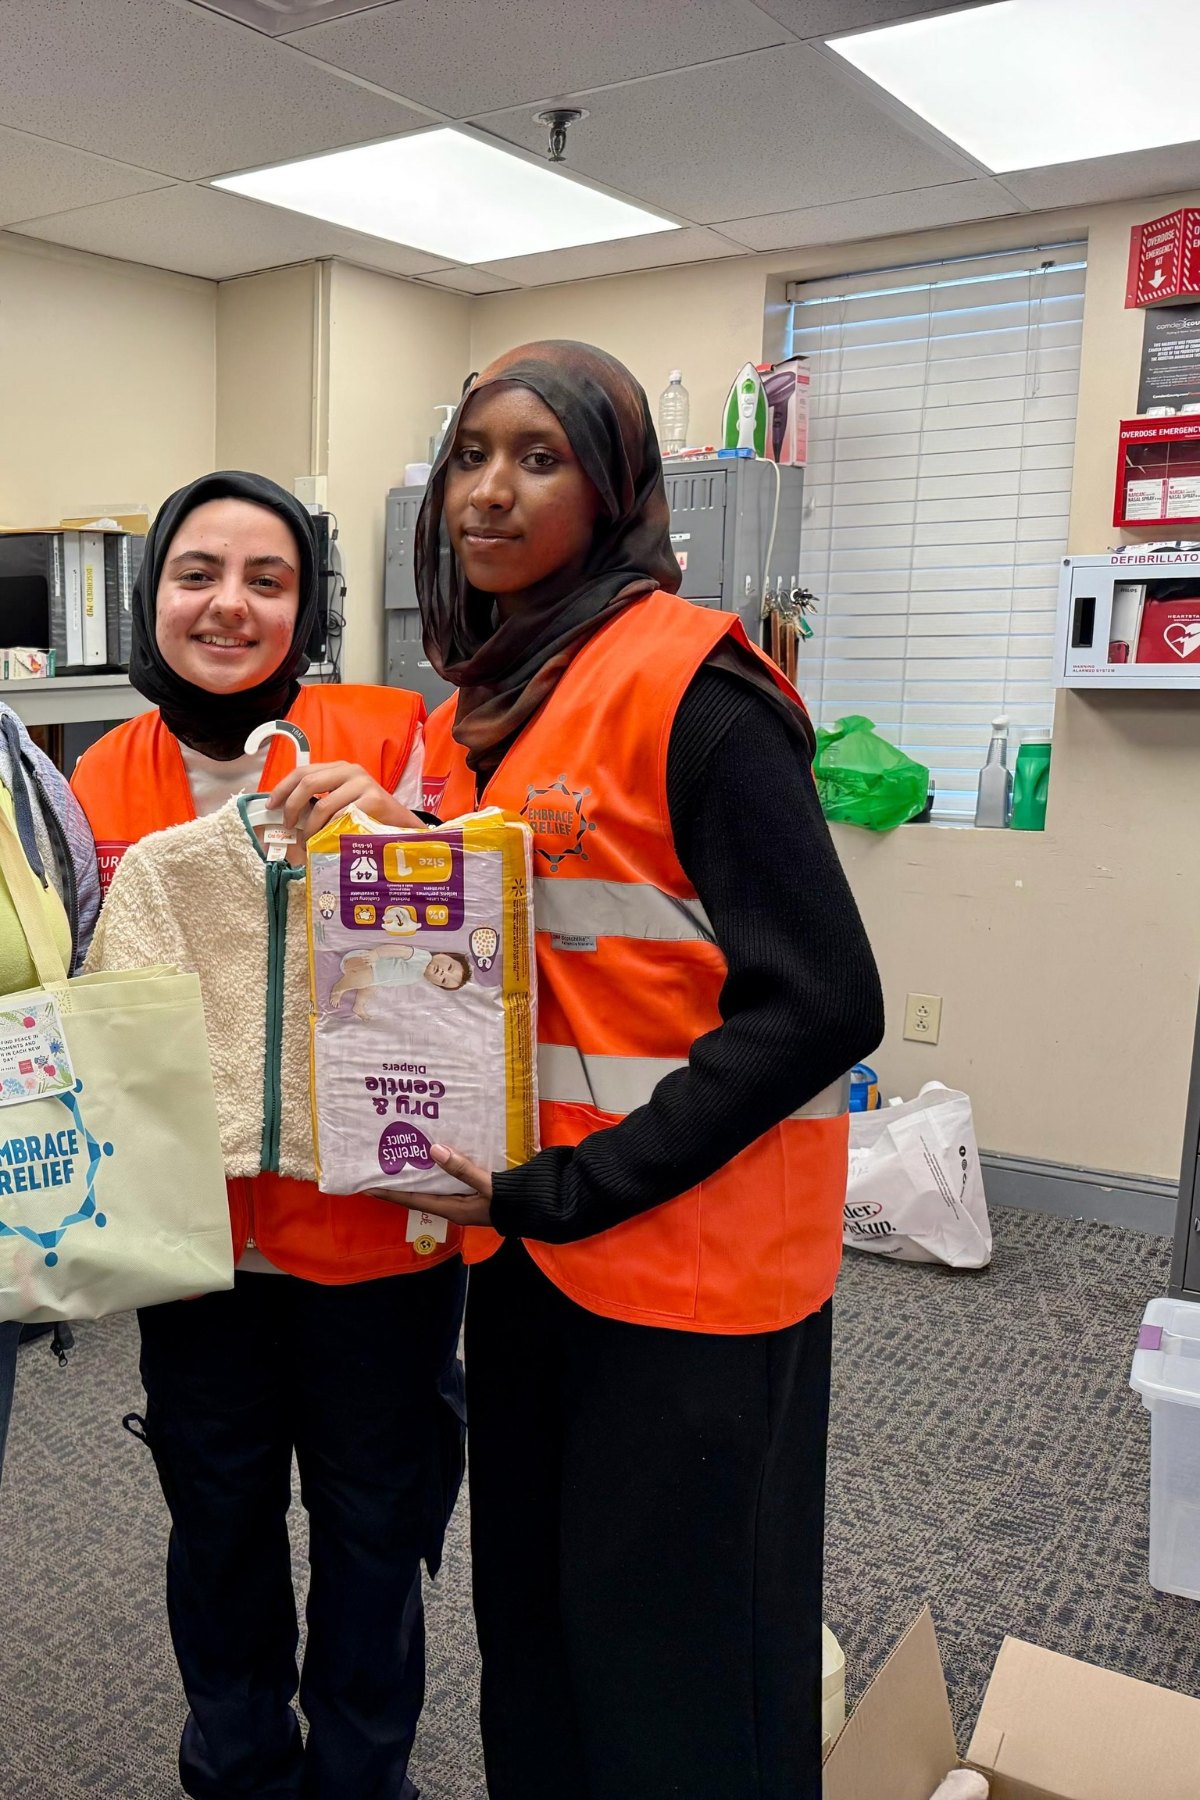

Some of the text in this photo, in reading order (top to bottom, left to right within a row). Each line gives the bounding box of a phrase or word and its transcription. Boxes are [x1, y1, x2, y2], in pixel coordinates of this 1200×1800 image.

[1146, 230, 1175, 248] OVERDOSE
[1146, 242, 1174, 260] EMERGENCY
[1154, 256, 1163, 266] KIT
[1121, 429, 1157, 439] OVERDOSE
[528, 808, 574, 824] EMBRACE
[530, 822, 572, 836] RELIEF
[396, 848, 445, 877] Size 1
[356, 871, 372, 880] 44
[429, 910, 446, 920] 0%
[382, 1062, 426, 1074] Diapers
[365, 1076, 446, 1099] Gentle
[372, 1094, 440, 1120] Dry &
[384, 1145, 428, 1166] Parent's
